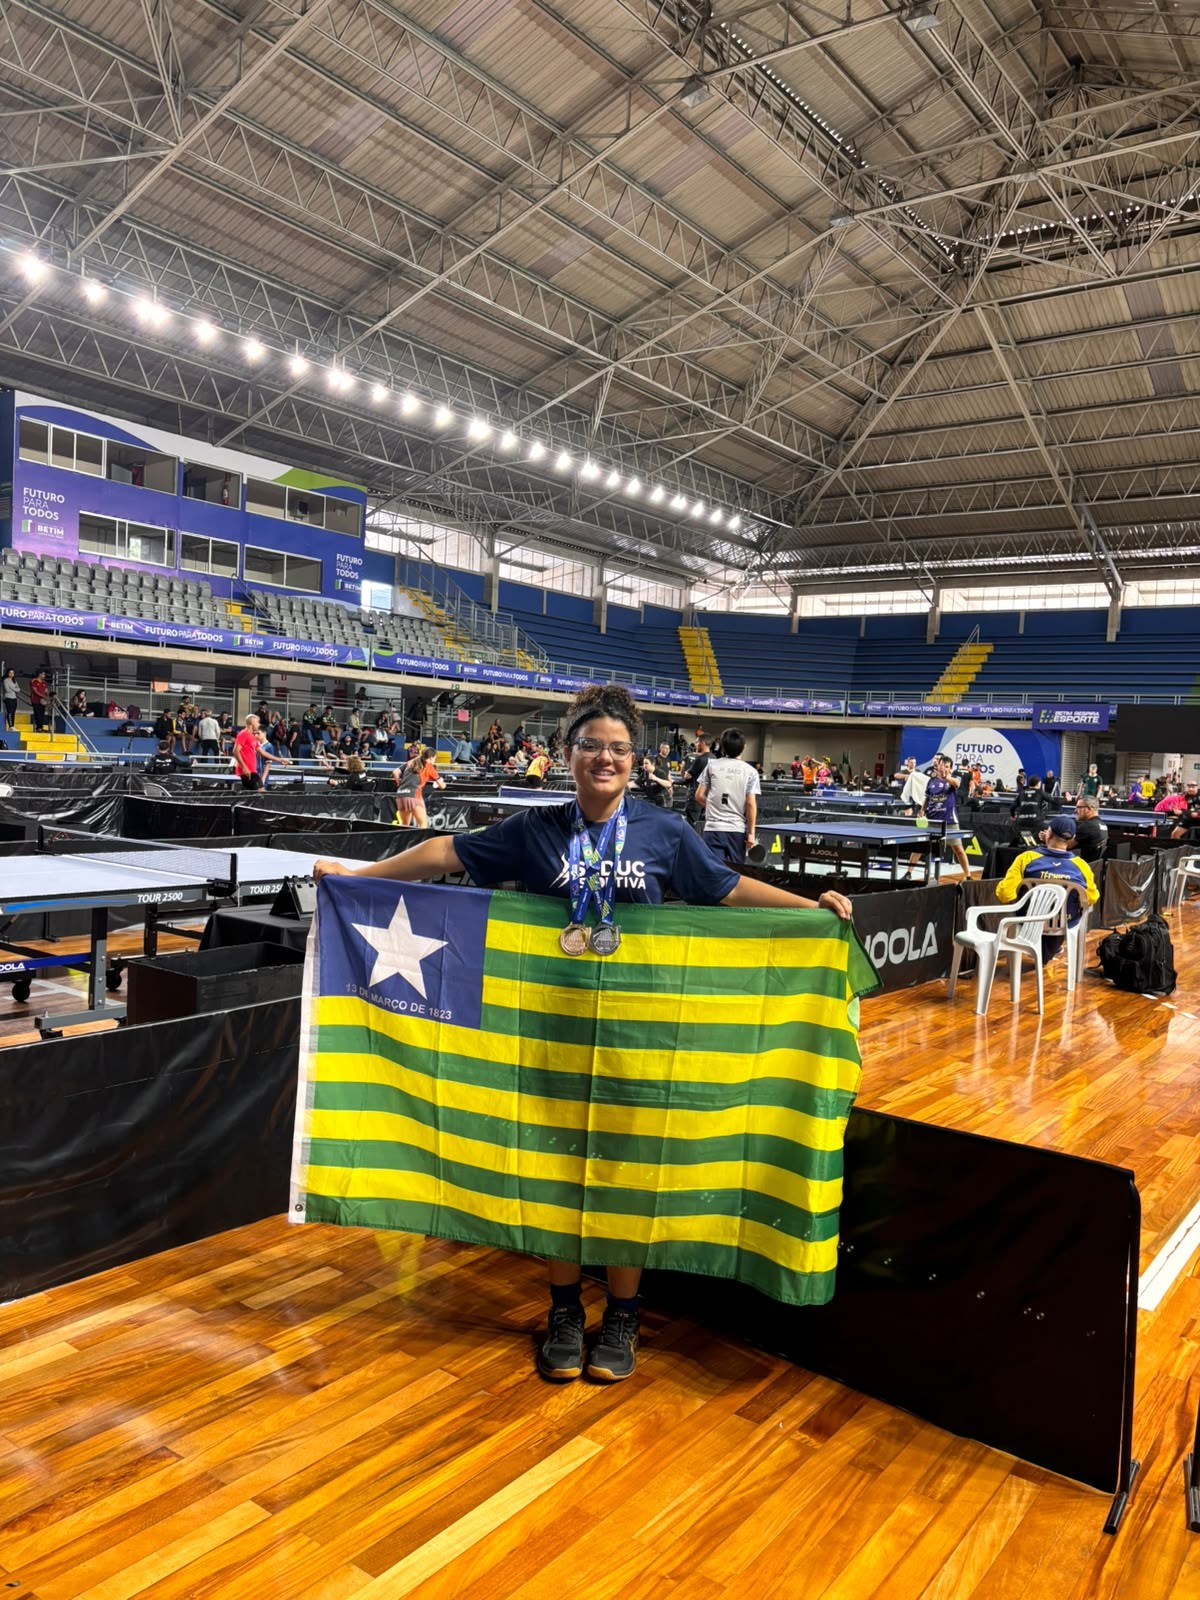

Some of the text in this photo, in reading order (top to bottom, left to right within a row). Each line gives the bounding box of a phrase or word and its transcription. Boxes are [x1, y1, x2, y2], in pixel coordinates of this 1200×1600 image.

[23, 487, 65, 503] FUTURO
[23, 497, 49, 509] PARA
[22, 505, 59, 520] TODOS
[37, 525, 64, 535] BETIM
[336, 553, 363, 566] FUTURO
[336, 561, 353, 570] PARA
[335, 568, 359, 579] TODOS
[0, 606, 27, 618] TURO
[111, 622, 134, 630] BETIM
[244, 638, 264, 646] BETIM
[1054, 715, 1099, 724] ESPORTE
[956, 743, 1003, 754] FUTURO
[955, 753, 984, 764] PARA
[955, 763, 995, 774] TOS
[428, 812, 468, 830] OLA
[816, 849, 839, 858] JOOLA
[579, 860, 646, 878] SDUC
[250, 883, 284, 895] TOUR 25
[137, 892, 183, 903] TOUR 2500
[0, 962, 25, 971] OOLA
[345, 983, 357, 993] 13
[371, 992, 408, 1011] MARÇO
[410, 1002, 426, 1014] DE
[428, 1007, 452, 1020] 1823
